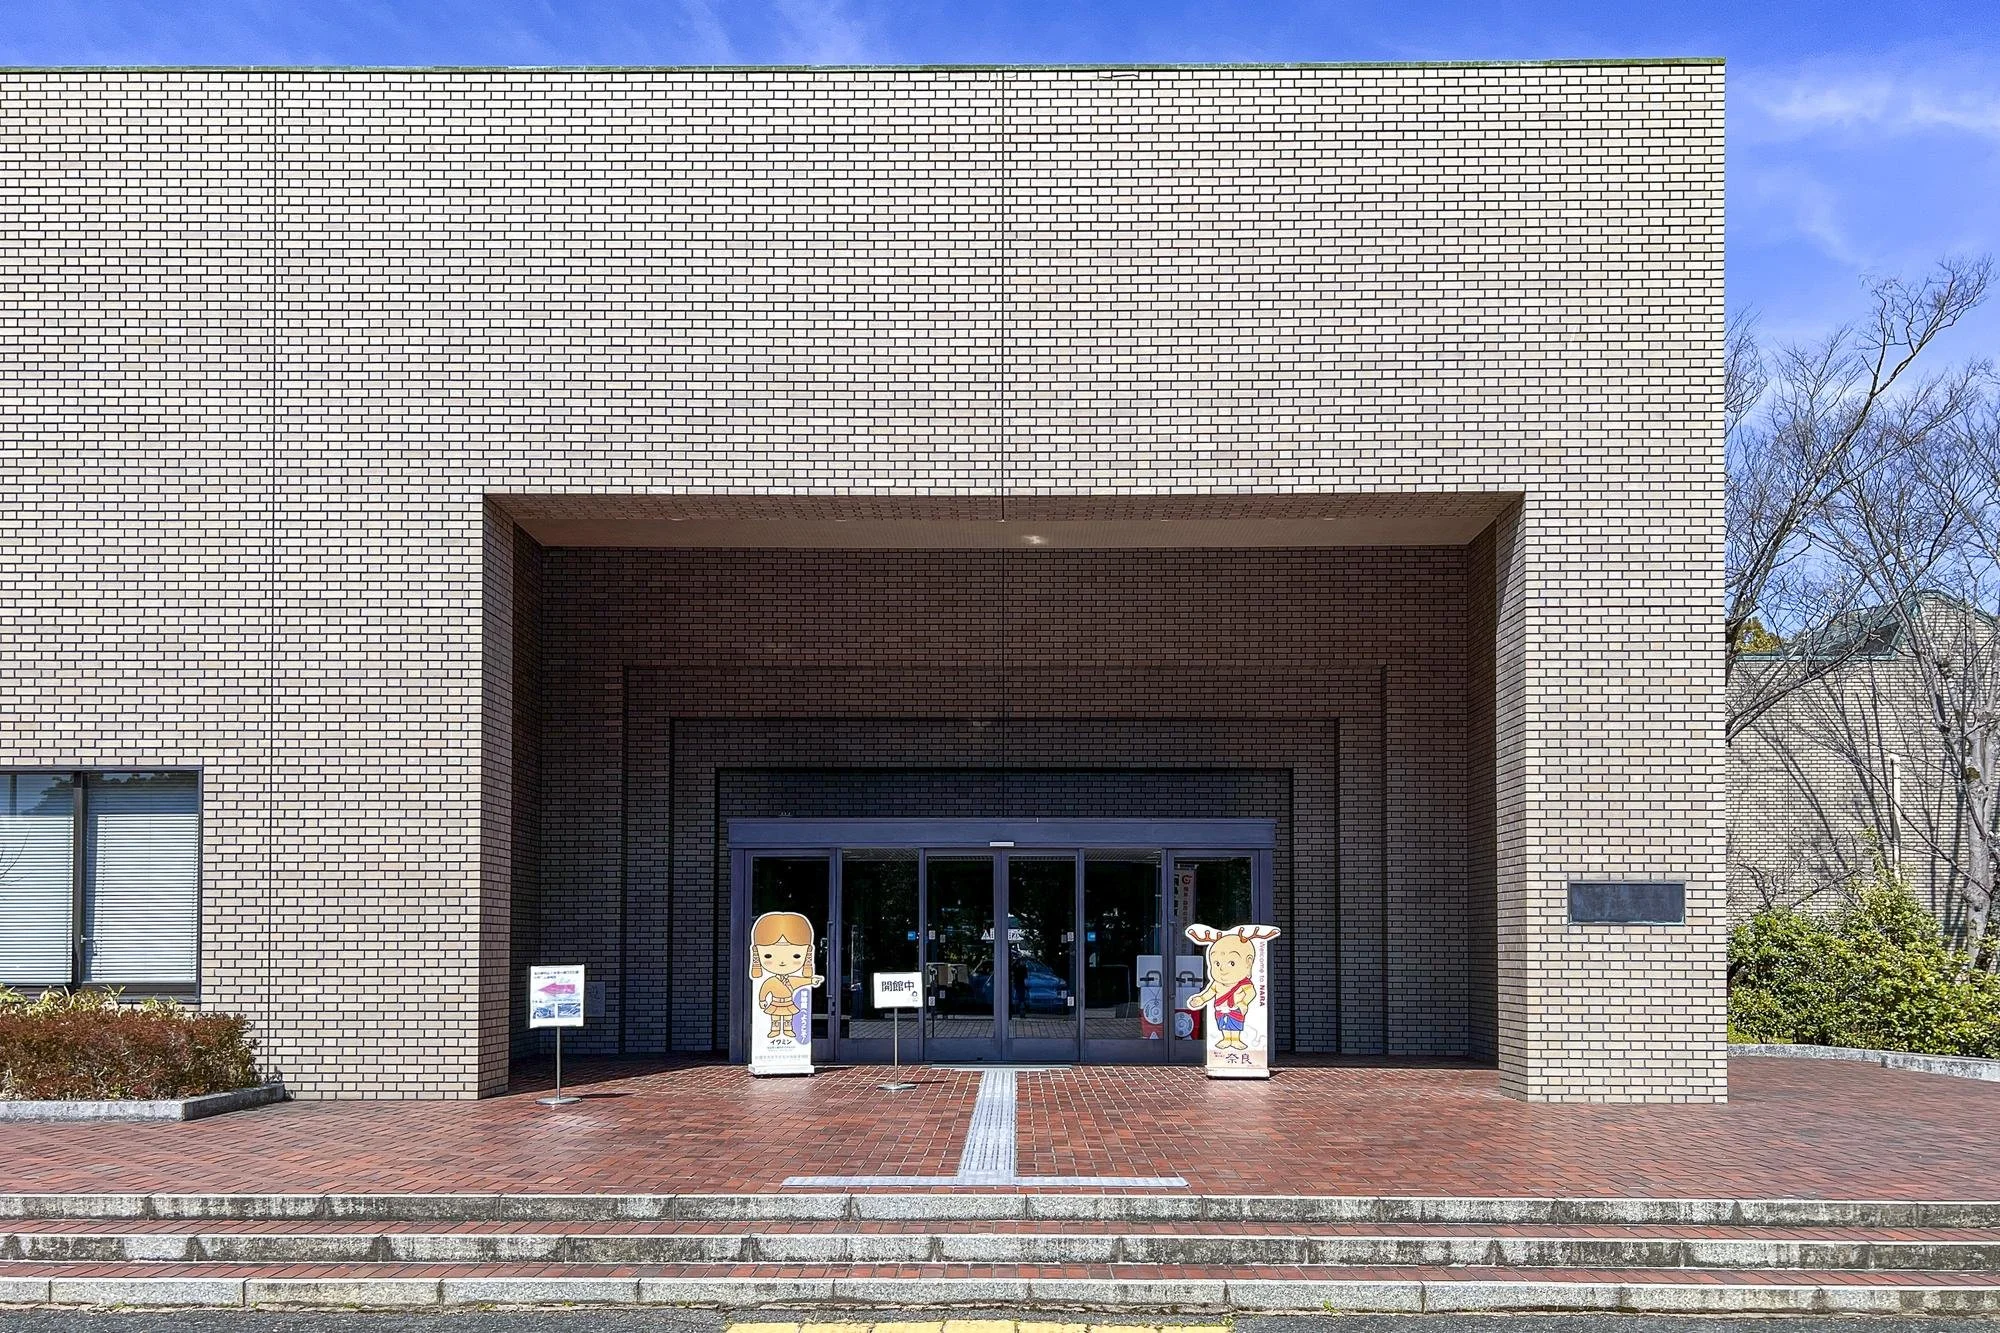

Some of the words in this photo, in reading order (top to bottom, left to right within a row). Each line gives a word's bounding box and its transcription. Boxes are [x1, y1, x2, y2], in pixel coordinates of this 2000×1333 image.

[881, 980, 915, 992] 開館中
[1225, 1053, 1252, 1065] 奈良
